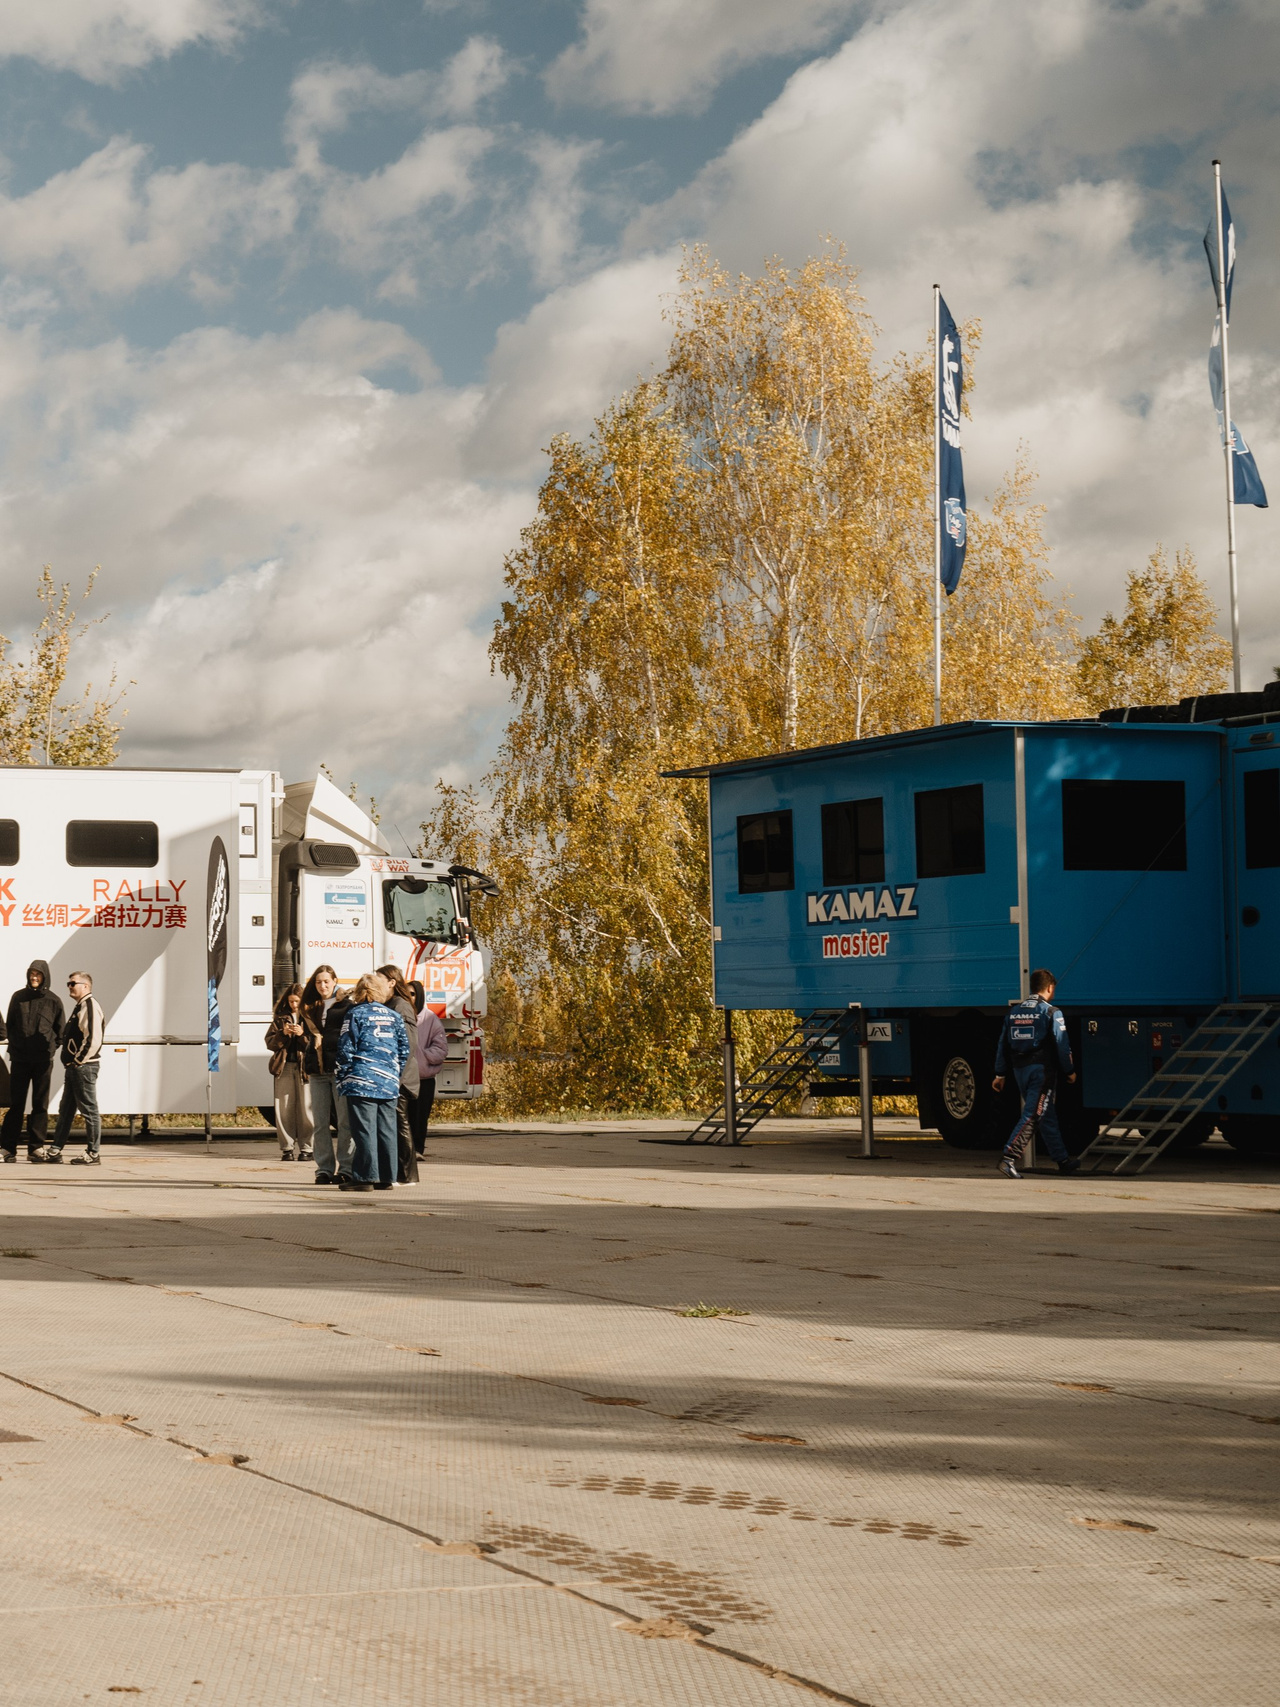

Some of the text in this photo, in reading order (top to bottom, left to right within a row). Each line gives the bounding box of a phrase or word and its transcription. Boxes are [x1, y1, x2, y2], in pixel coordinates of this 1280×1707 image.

[387, 864, 410, 872] WAY
[93, 879, 187, 902] RALLY
[22, 903, 187, 928] 丝绸之路拉力赛
[806, 884, 918, 925] KAMAZ
[308, 941, 373, 949] ORGANIZATION
[822, 929, 889, 958] master
[429, 966, 462, 991] PC2
